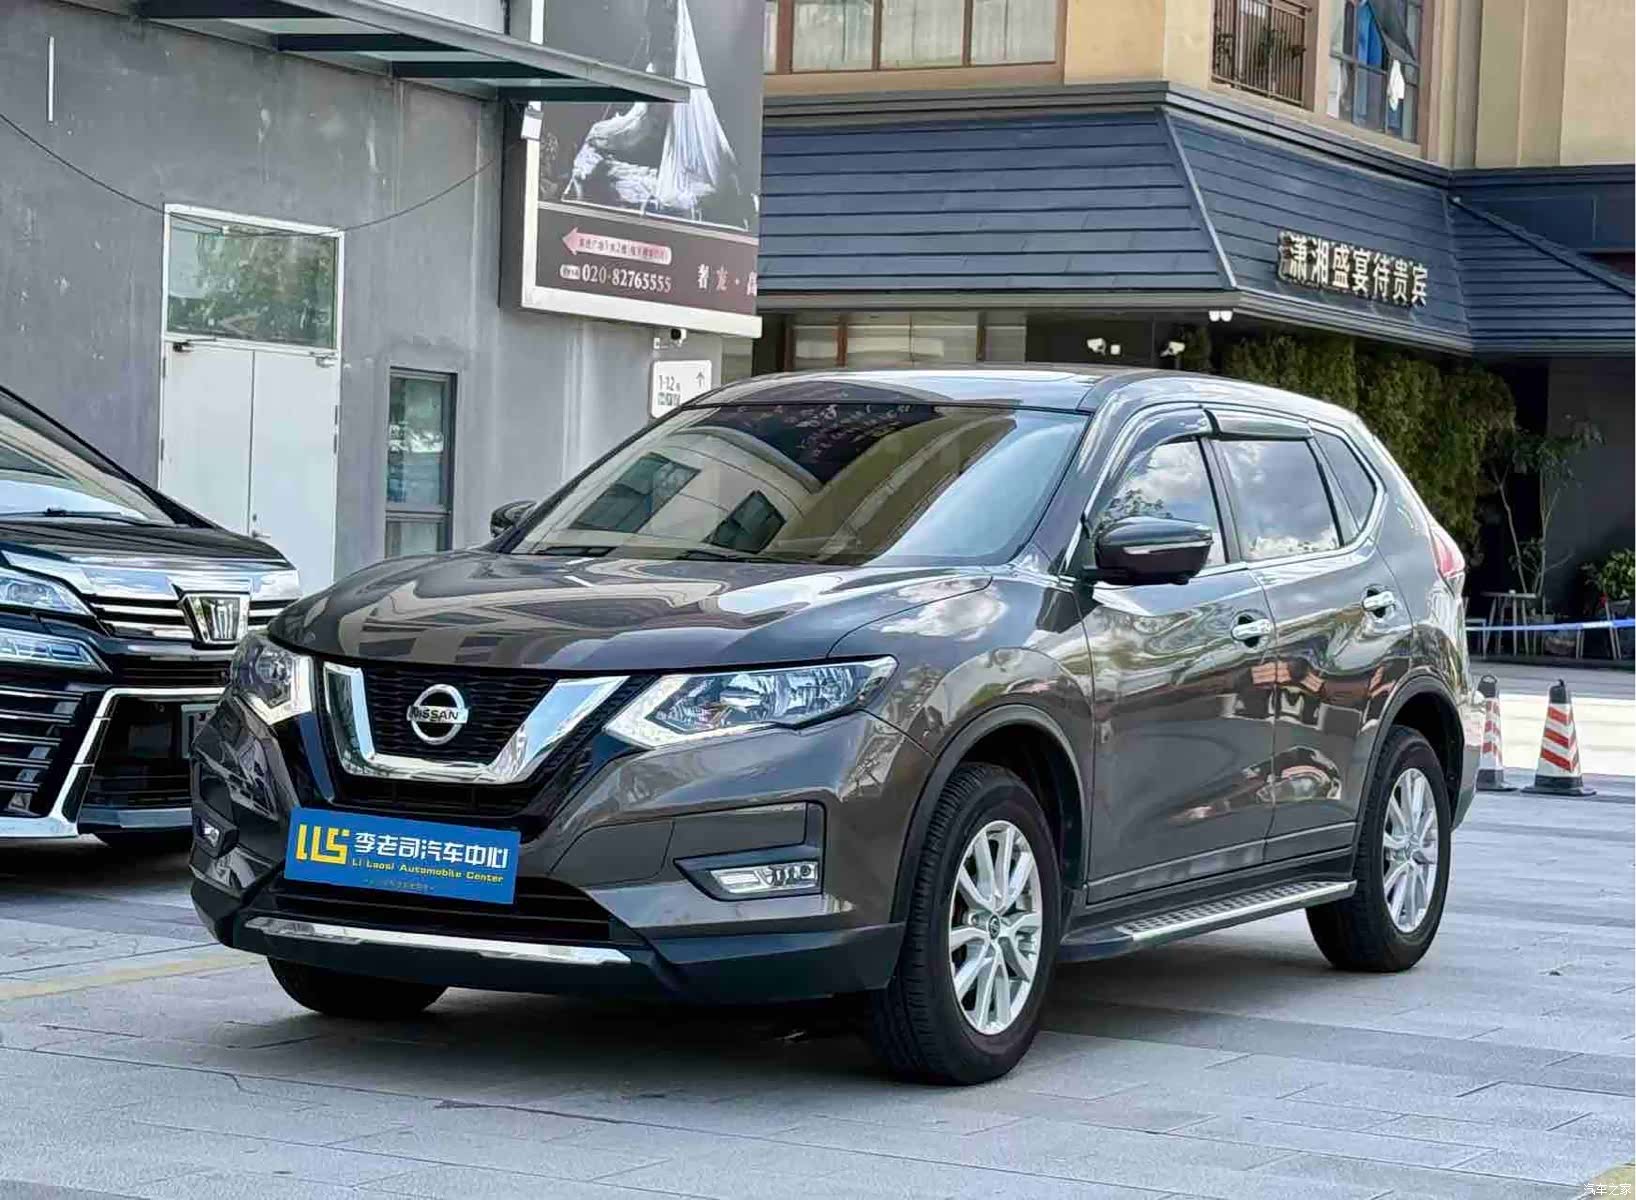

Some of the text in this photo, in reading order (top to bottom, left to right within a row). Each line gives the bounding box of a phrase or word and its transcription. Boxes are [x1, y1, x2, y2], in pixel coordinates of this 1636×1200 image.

[1278, 232, 1428, 307] 潇湘盛宴待贵宾
[408, 705, 459, 720] NISSAN
[353, 831, 508, 869] 李老司汽车中心
[400, 864, 462, 878] Automobile
[466, 870, 504, 884] Center
